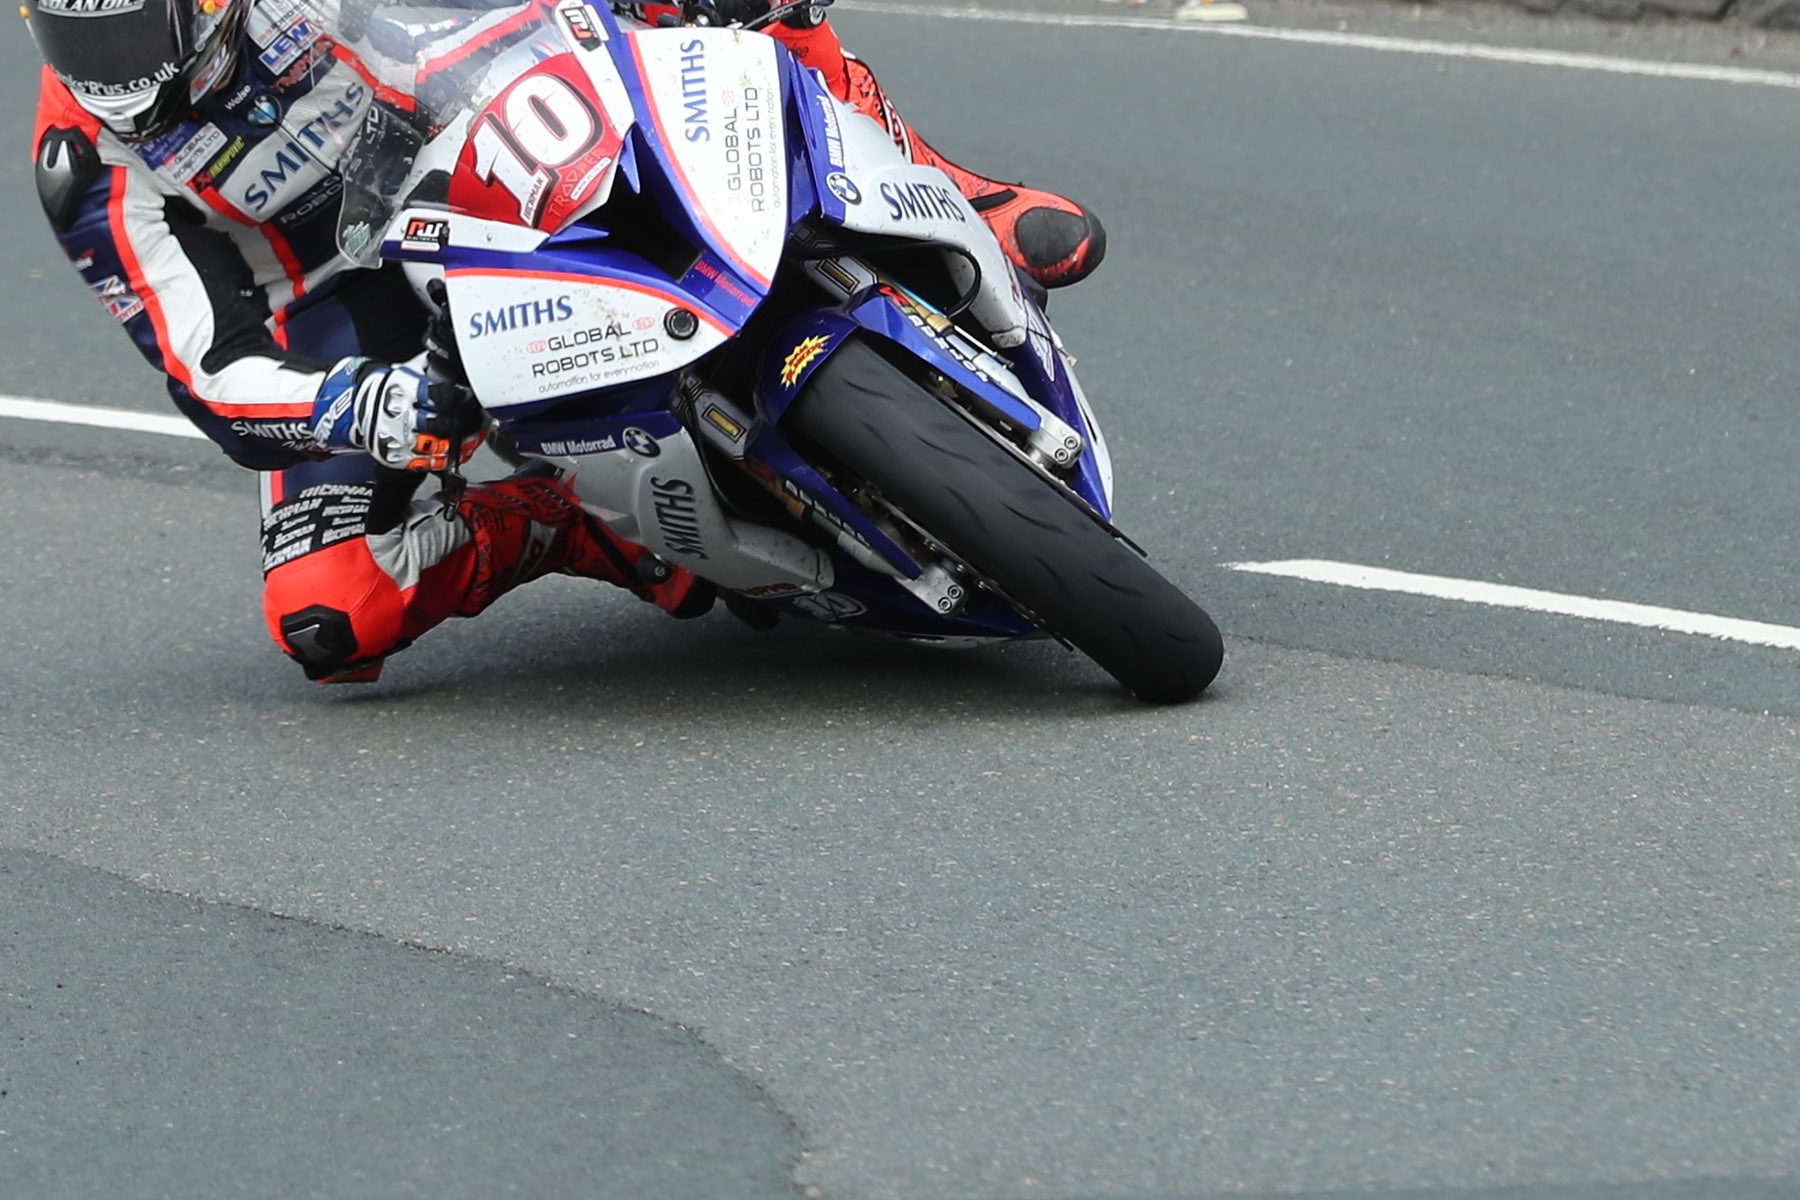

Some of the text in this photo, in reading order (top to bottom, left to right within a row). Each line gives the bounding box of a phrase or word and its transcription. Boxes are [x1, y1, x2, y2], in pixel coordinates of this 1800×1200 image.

[261, 21, 312, 66] LEW
[680, 39, 711, 143] SMITHS
[203, 130, 221, 147] LTD
[244, 82, 365, 213] SMITHS
[473, 73, 601, 227] 10
[724, 108, 742, 191] GLOBAL
[745, 87, 766, 212] ROBOTS LTD
[768, 115, 777, 140] every
[827, 138, 844, 168] BMW
[770, 155, 781, 209] automation
[880, 182, 966, 223] SMITHS
[695, 260, 757, 309] BMW Motorrad
[469, 295, 574, 340] SMITHS
[547, 322, 632, 352] GLOBAL
[532, 338, 659, 379] ROBOTS LTD
[538, 360, 660, 394] automation for every nation
[231, 421, 314, 441] SMITHS
[541, 435, 617, 455] BMW Motorrad
[650, 476, 710, 560] SMITHS
